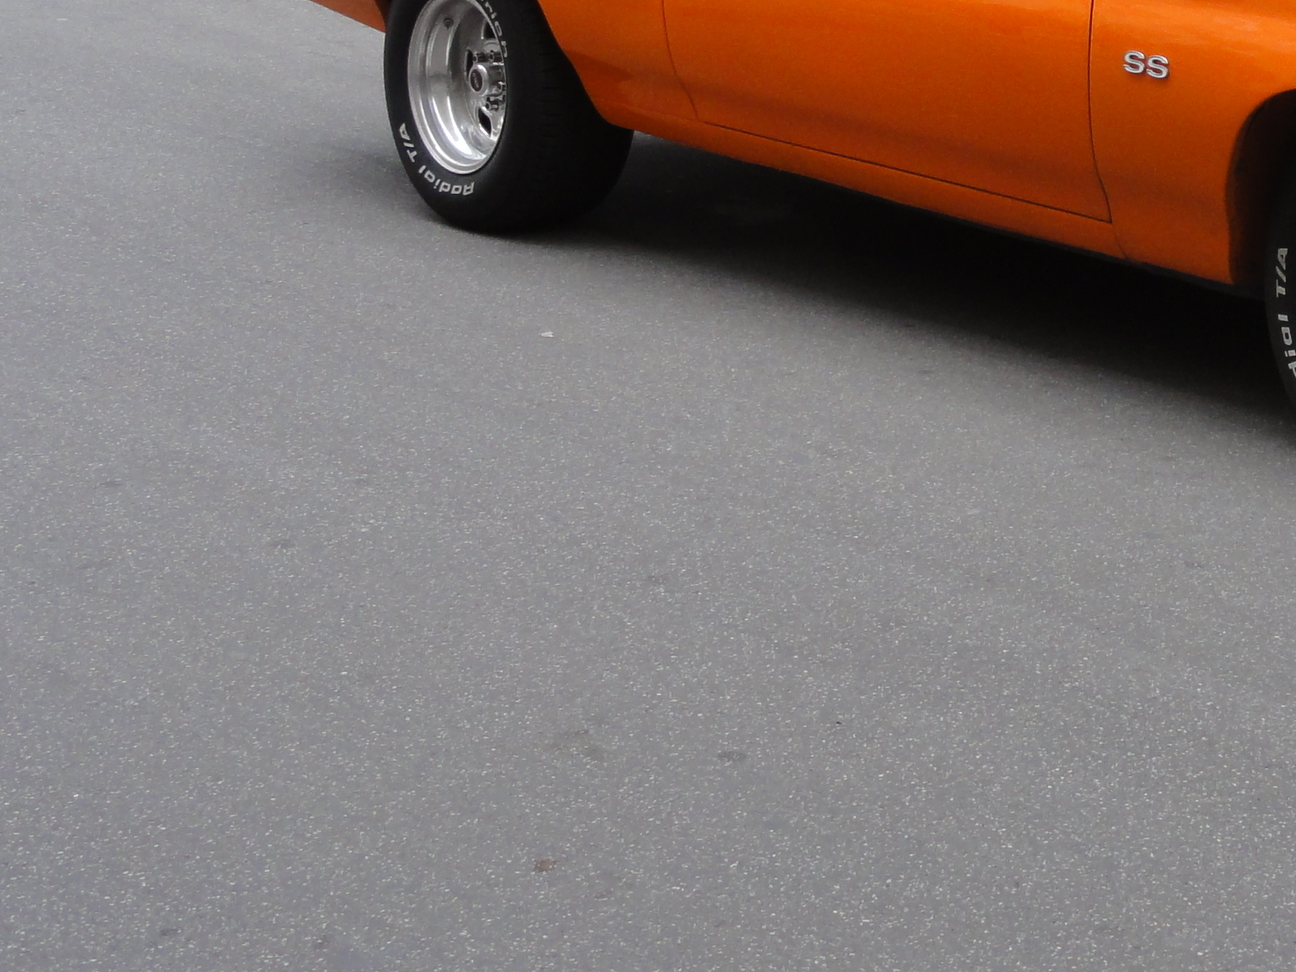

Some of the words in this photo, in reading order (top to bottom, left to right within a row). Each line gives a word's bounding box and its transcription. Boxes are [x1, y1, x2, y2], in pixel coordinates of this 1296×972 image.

[1122, 49, 1170, 80] SS
[398, 122, 418, 161] T/A
[418, 164, 475, 196] Radial
[1275, 247, 1289, 298] T/A
